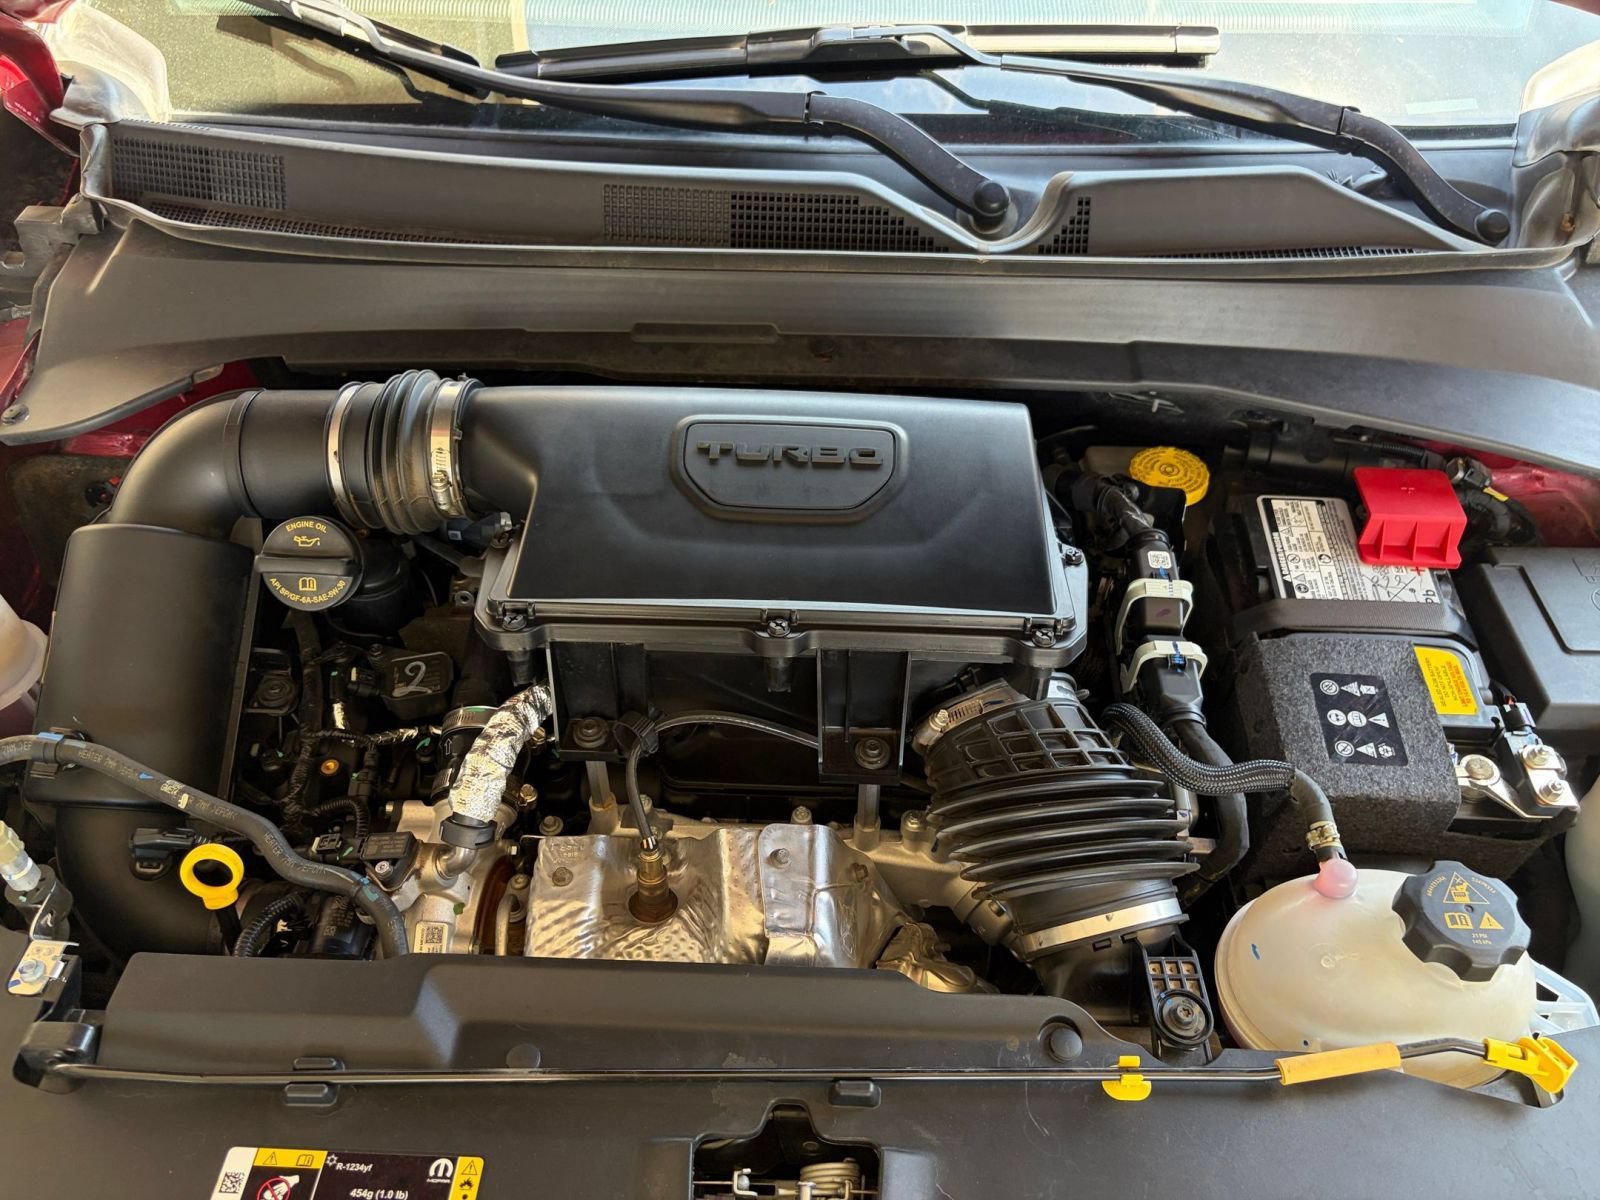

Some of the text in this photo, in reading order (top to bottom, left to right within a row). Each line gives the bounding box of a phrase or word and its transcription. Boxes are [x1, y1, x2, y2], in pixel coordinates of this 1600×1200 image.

[696, 441, 884, 467] TURBO
[286, 521, 327, 533] ENGINE OIL
[270, 578, 281, 590] API
[392, 661, 433, 697] 2
[335, 1162, 373, 1173] R-1234yf
[349, 1189, 409, 1200] 454g (1.0 lb)
